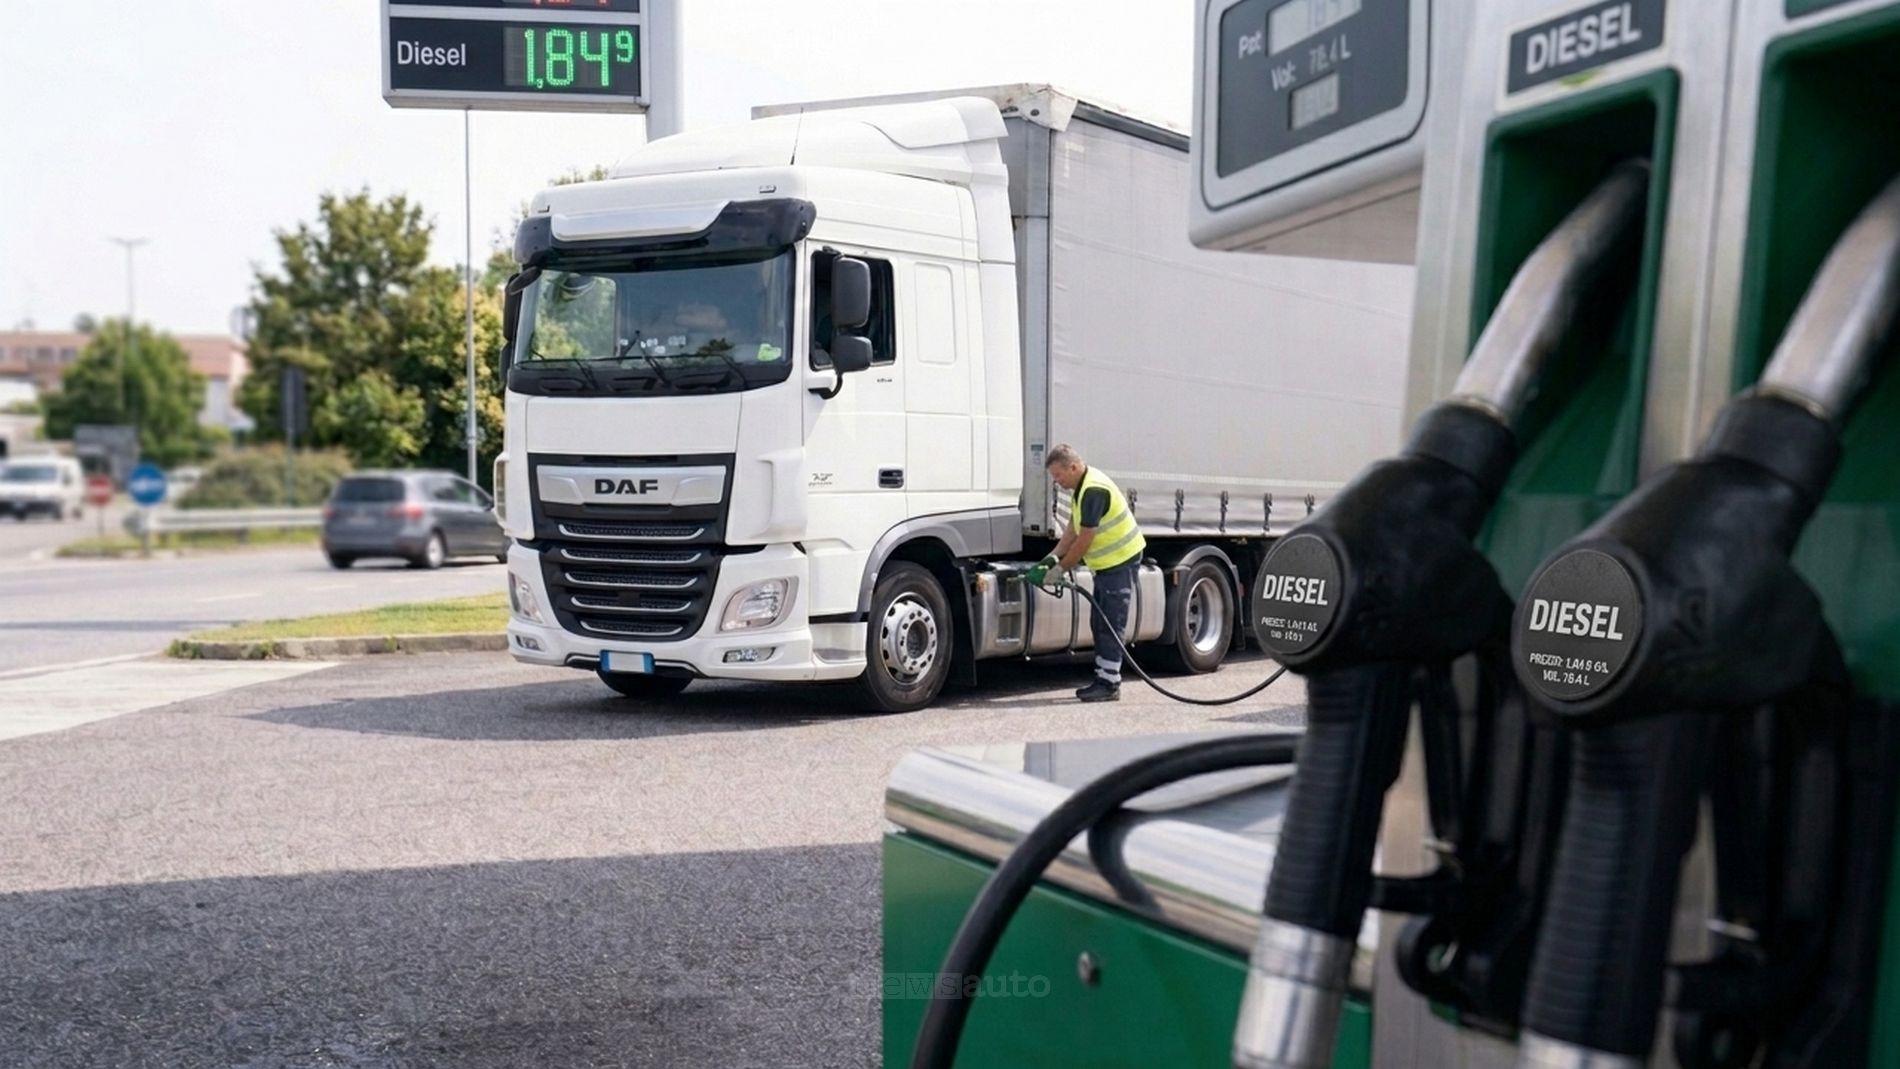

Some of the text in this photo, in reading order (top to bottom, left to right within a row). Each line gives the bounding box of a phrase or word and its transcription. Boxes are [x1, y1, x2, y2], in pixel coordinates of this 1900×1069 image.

[397, 40, 466, 66] Diesel
[1526, 2, 1642, 75] DIESEL
[595, 479, 658, 495] DAF
[1262, 574, 1328, 606] DIESEL
[1529, 598, 1623, 640] DIESEL
